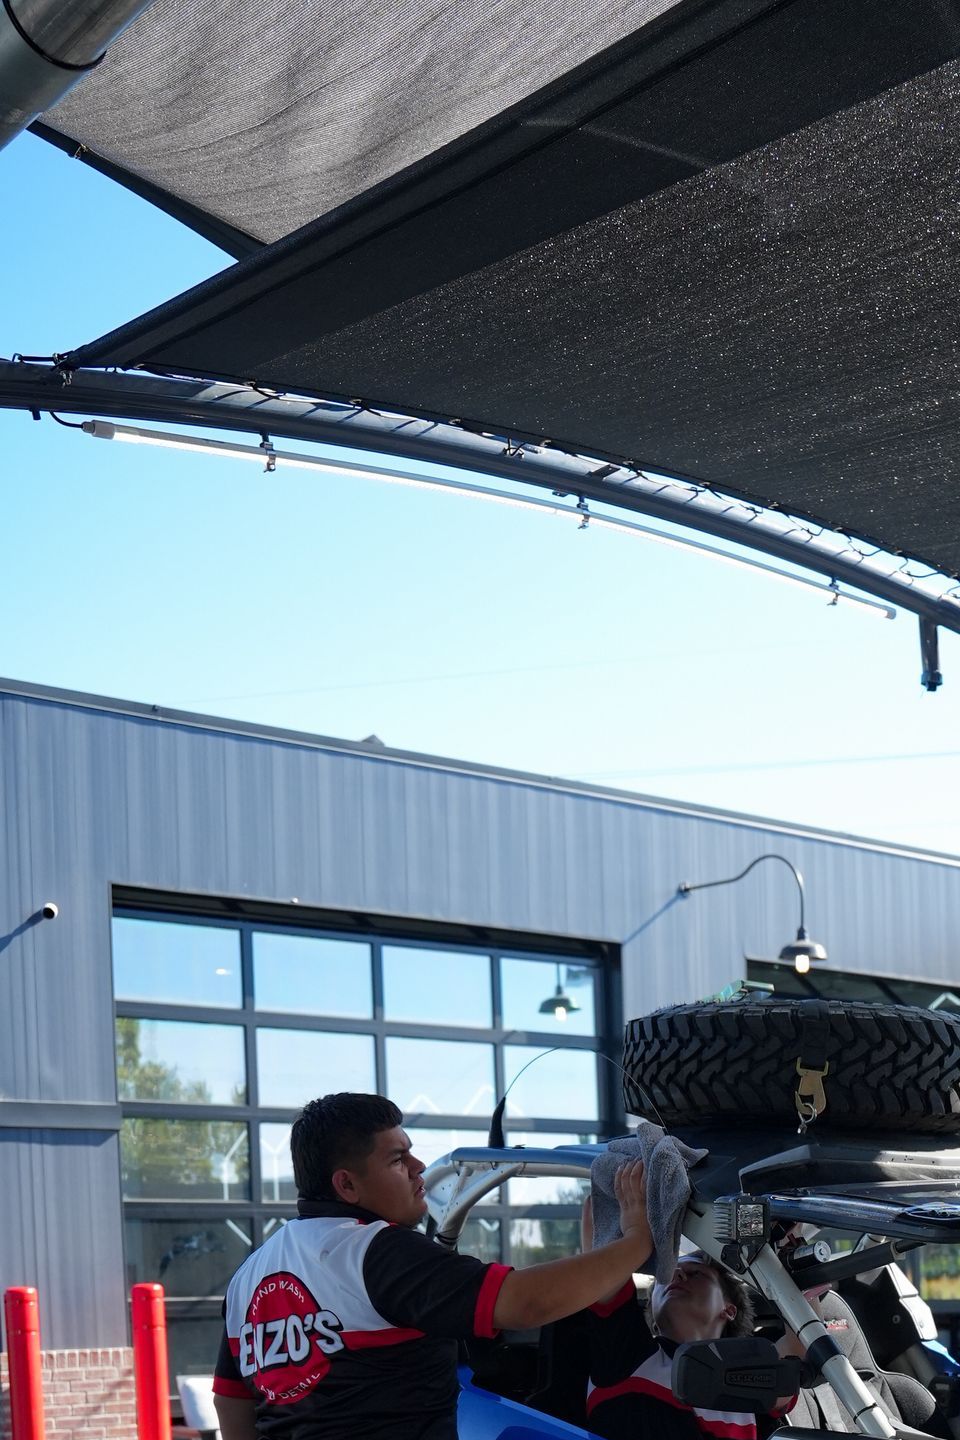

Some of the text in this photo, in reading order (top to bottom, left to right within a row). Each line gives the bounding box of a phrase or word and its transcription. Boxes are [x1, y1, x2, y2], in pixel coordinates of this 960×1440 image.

[252, 1280, 304, 1316] HAND WASH
[239, 1309, 344, 1378] ENZO'S
[259, 1372, 321, 1400] AND DETAIL
